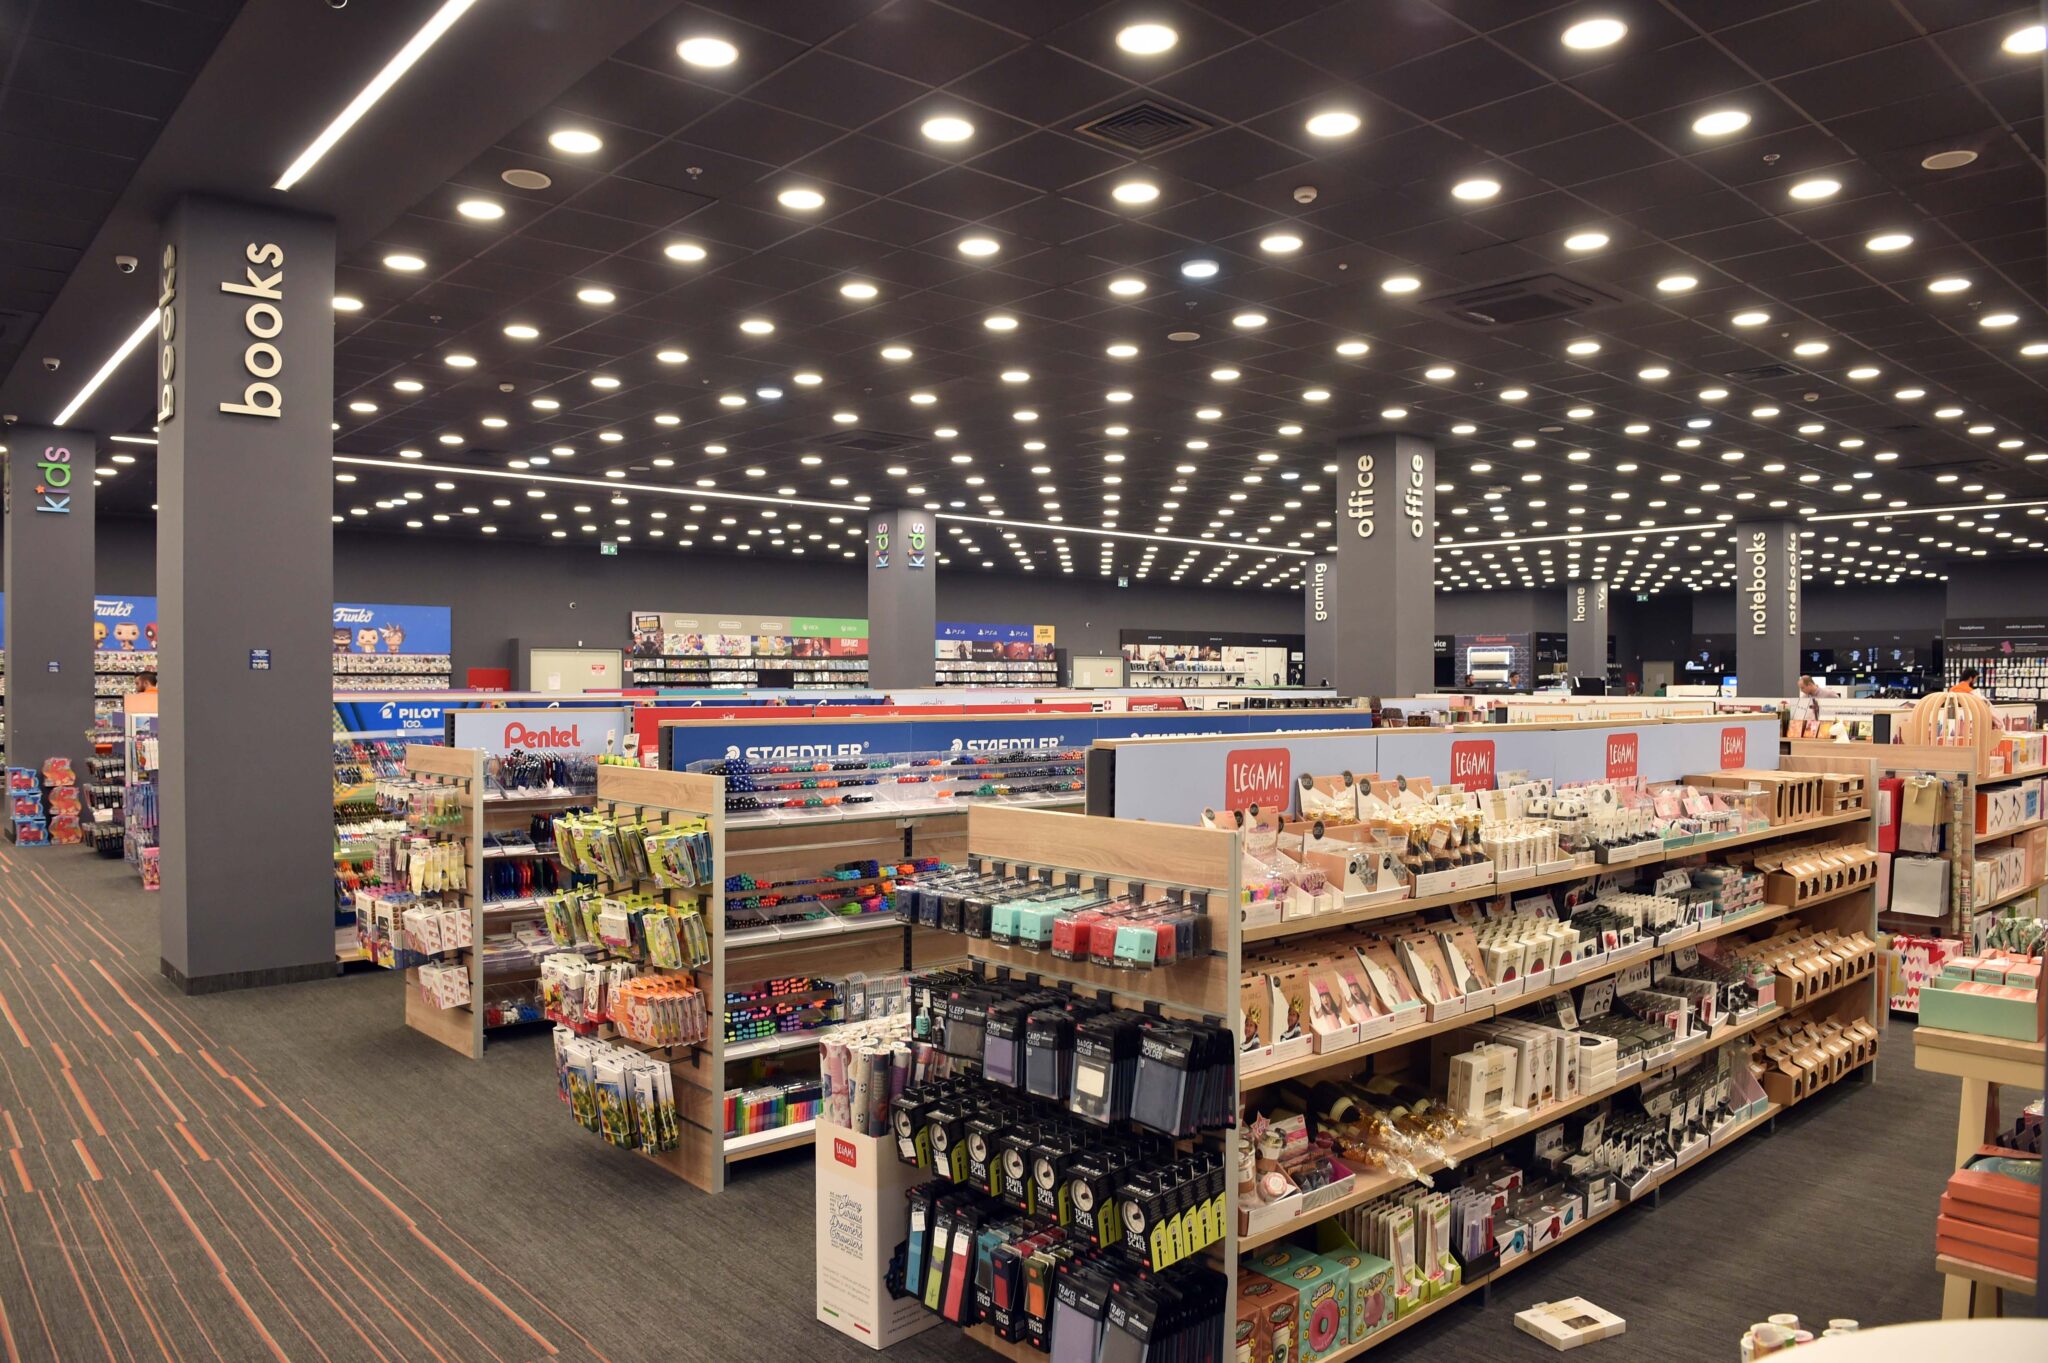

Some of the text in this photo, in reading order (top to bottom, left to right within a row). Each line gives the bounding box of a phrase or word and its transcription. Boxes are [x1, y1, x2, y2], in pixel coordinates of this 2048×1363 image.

[220, 242, 284, 418] books
[35, 446, 71, 513] kids
[1348, 454, 1374, 538] office
[1405, 454, 1423, 538] office
[874, 523, 889, 568] kids
[908, 523, 926, 567] kids
[1745, 532, 1766, 635] notebooks
[1787, 532, 1797, 635] notebooks
[1312, 563, 1327, 622] gaming
[1573, 587, 1585, 621] home
[333, 607, 374, 623] Funko
[399, 708, 441, 719] PILOT
[504, 721, 581, 749] Pentel
[746, 743, 863, 759] STAEDTLER
[966, 737, 1060, 751] STAEDTLER
[948, 1004, 965, 1015] SLEEP
[986, 1020, 1001, 1031] CARD
[1026, 1031, 1041, 1041] CARD
[1076, 1038, 1093, 1050] BADGE
[1142, 1047, 1163, 1060] HOLDER
[971, 1165, 987, 1179] SCALE
[1006, 1182, 1023, 1197] SCALE
[1037, 1193, 1055, 1208] SCALE
[1075, 1214, 1094, 1229] SCALE
[1127, 1237, 1146, 1252] SCALE
[1058, 1283, 1076, 1300] TRAVEL
[1110, 1303, 1126, 1321] TRAVEL
